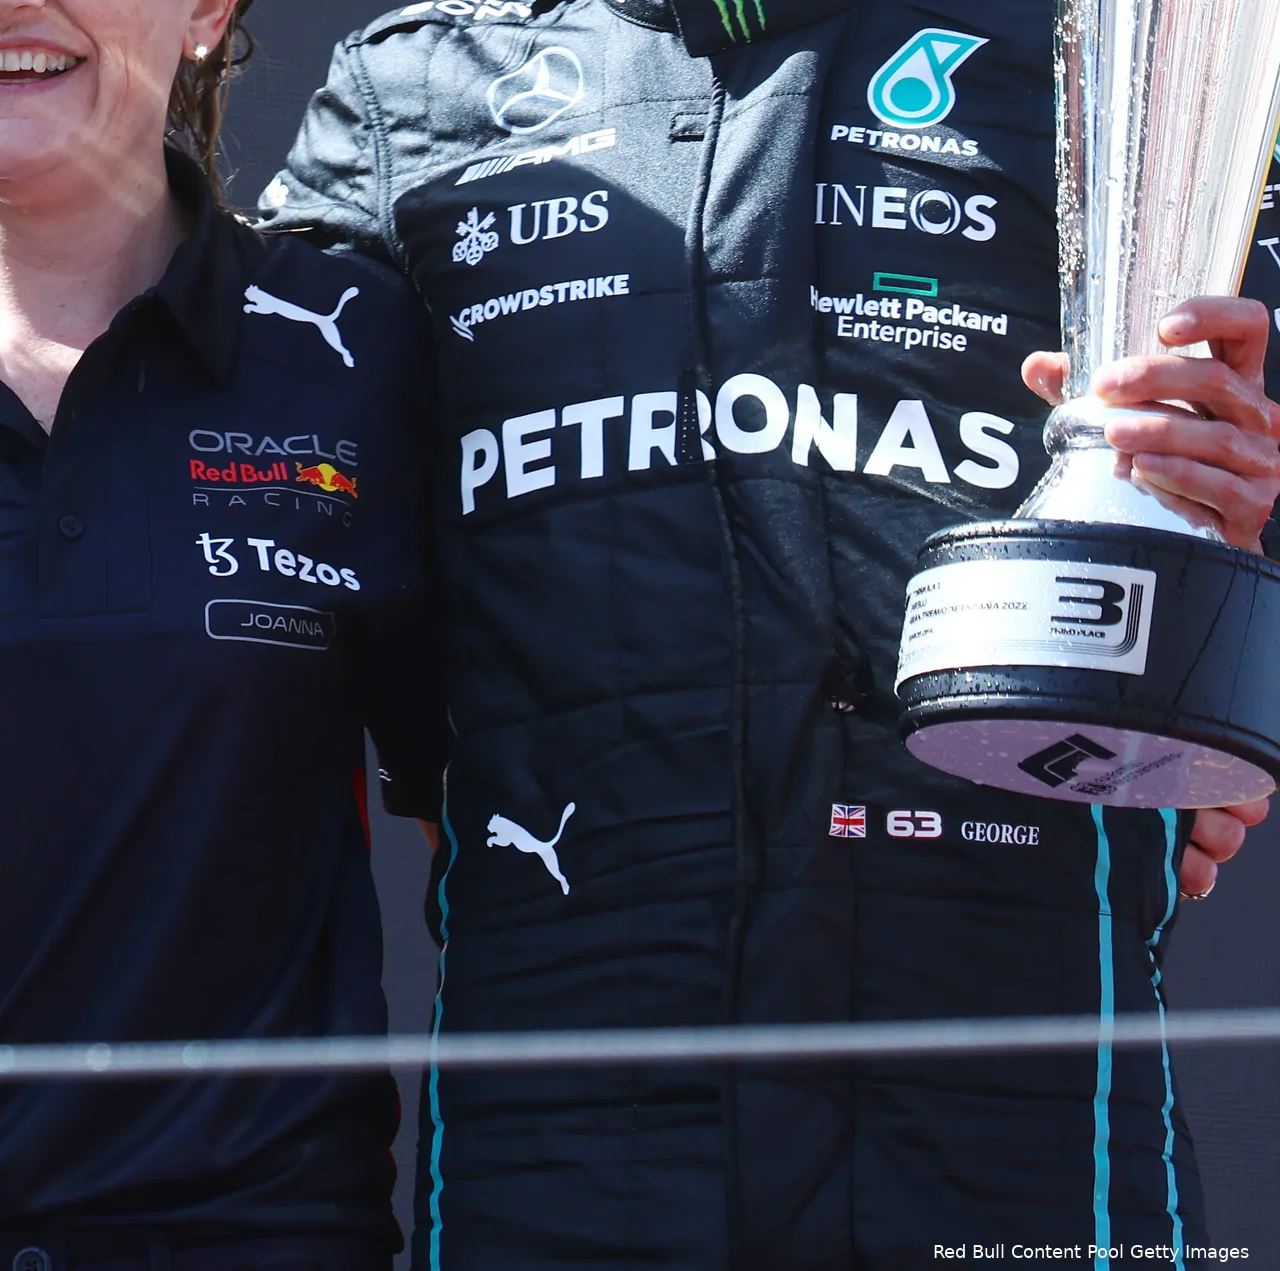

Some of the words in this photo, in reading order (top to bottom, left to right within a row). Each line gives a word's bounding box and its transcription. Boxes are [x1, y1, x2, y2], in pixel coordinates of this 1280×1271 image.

[830, 124, 979, 157] PETRONAS
[507, 189, 610, 245] UBS
[814, 182, 998, 242] INEOS
[458, 273, 630, 329] CROWDSTRIKE
[809, 285, 902, 319] Hewlett
[906, 298, 1007, 336] Packard
[837, 315, 968, 352] Enterprise
[189, 429, 358, 467] ORACLE
[460, 372, 1020, 515] PETRONAS
[190, 459, 238, 482] Red
[240, 461, 289, 483] Bull
[193, 492, 353, 528] RACING
[247, 537, 361, 592] Tezos
[1050, 576, 1126, 627] 3
[241, 613, 325, 637] JOANNA
[887, 810, 943, 839] 63
[960, 821, 1040, 846] GEORGE
